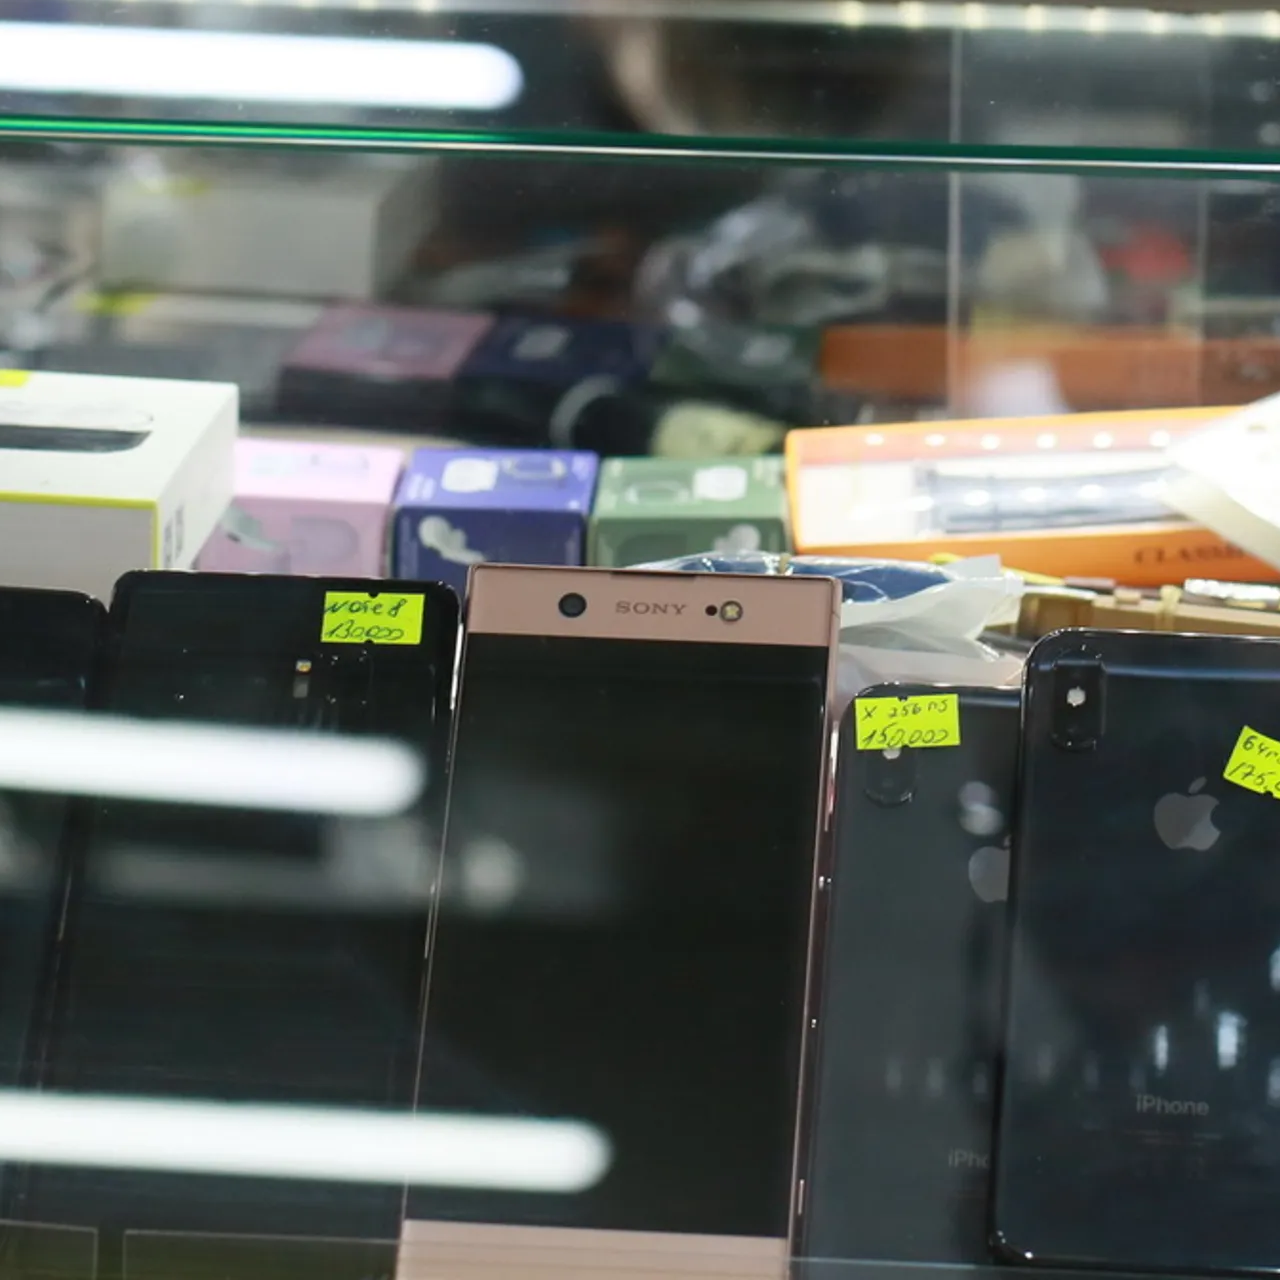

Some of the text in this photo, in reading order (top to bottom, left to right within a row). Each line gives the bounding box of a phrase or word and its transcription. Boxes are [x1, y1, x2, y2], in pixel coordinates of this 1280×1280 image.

[614, 599, 689, 616] SONY
[1135, 1094, 1210, 1117] iPhone
[948, 1147, 989, 1169] iPho
